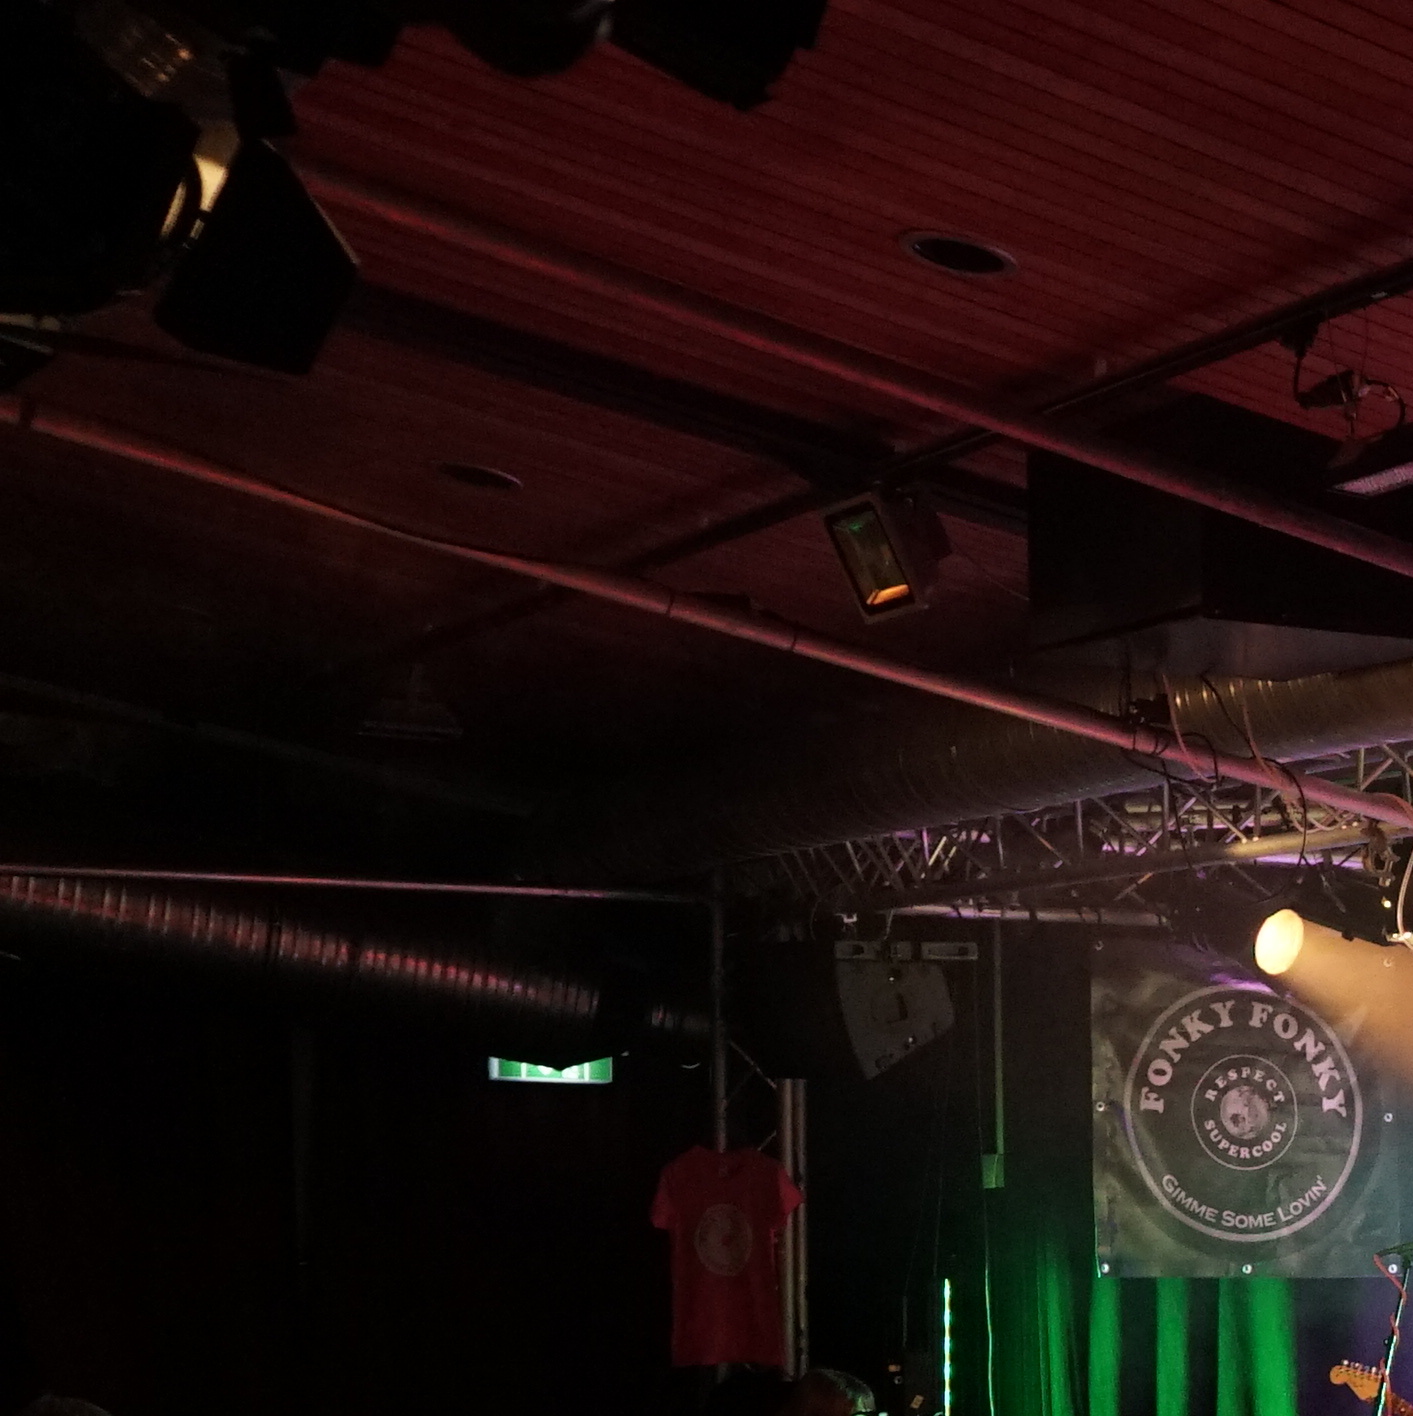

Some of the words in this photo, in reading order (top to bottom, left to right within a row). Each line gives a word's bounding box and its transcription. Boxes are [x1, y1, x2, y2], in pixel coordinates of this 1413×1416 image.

[1140, 1000, 1235, 1115] FONKY
[1249, 1001, 1347, 1119] FONKY
[1204, 1066, 1286, 1102] RESPECT
[1203, 1119, 1288, 1160] SUPERCOOL
[1161, 1174, 1219, 1223] GIMME
[1221, 1210, 1277, 1229] SOME
